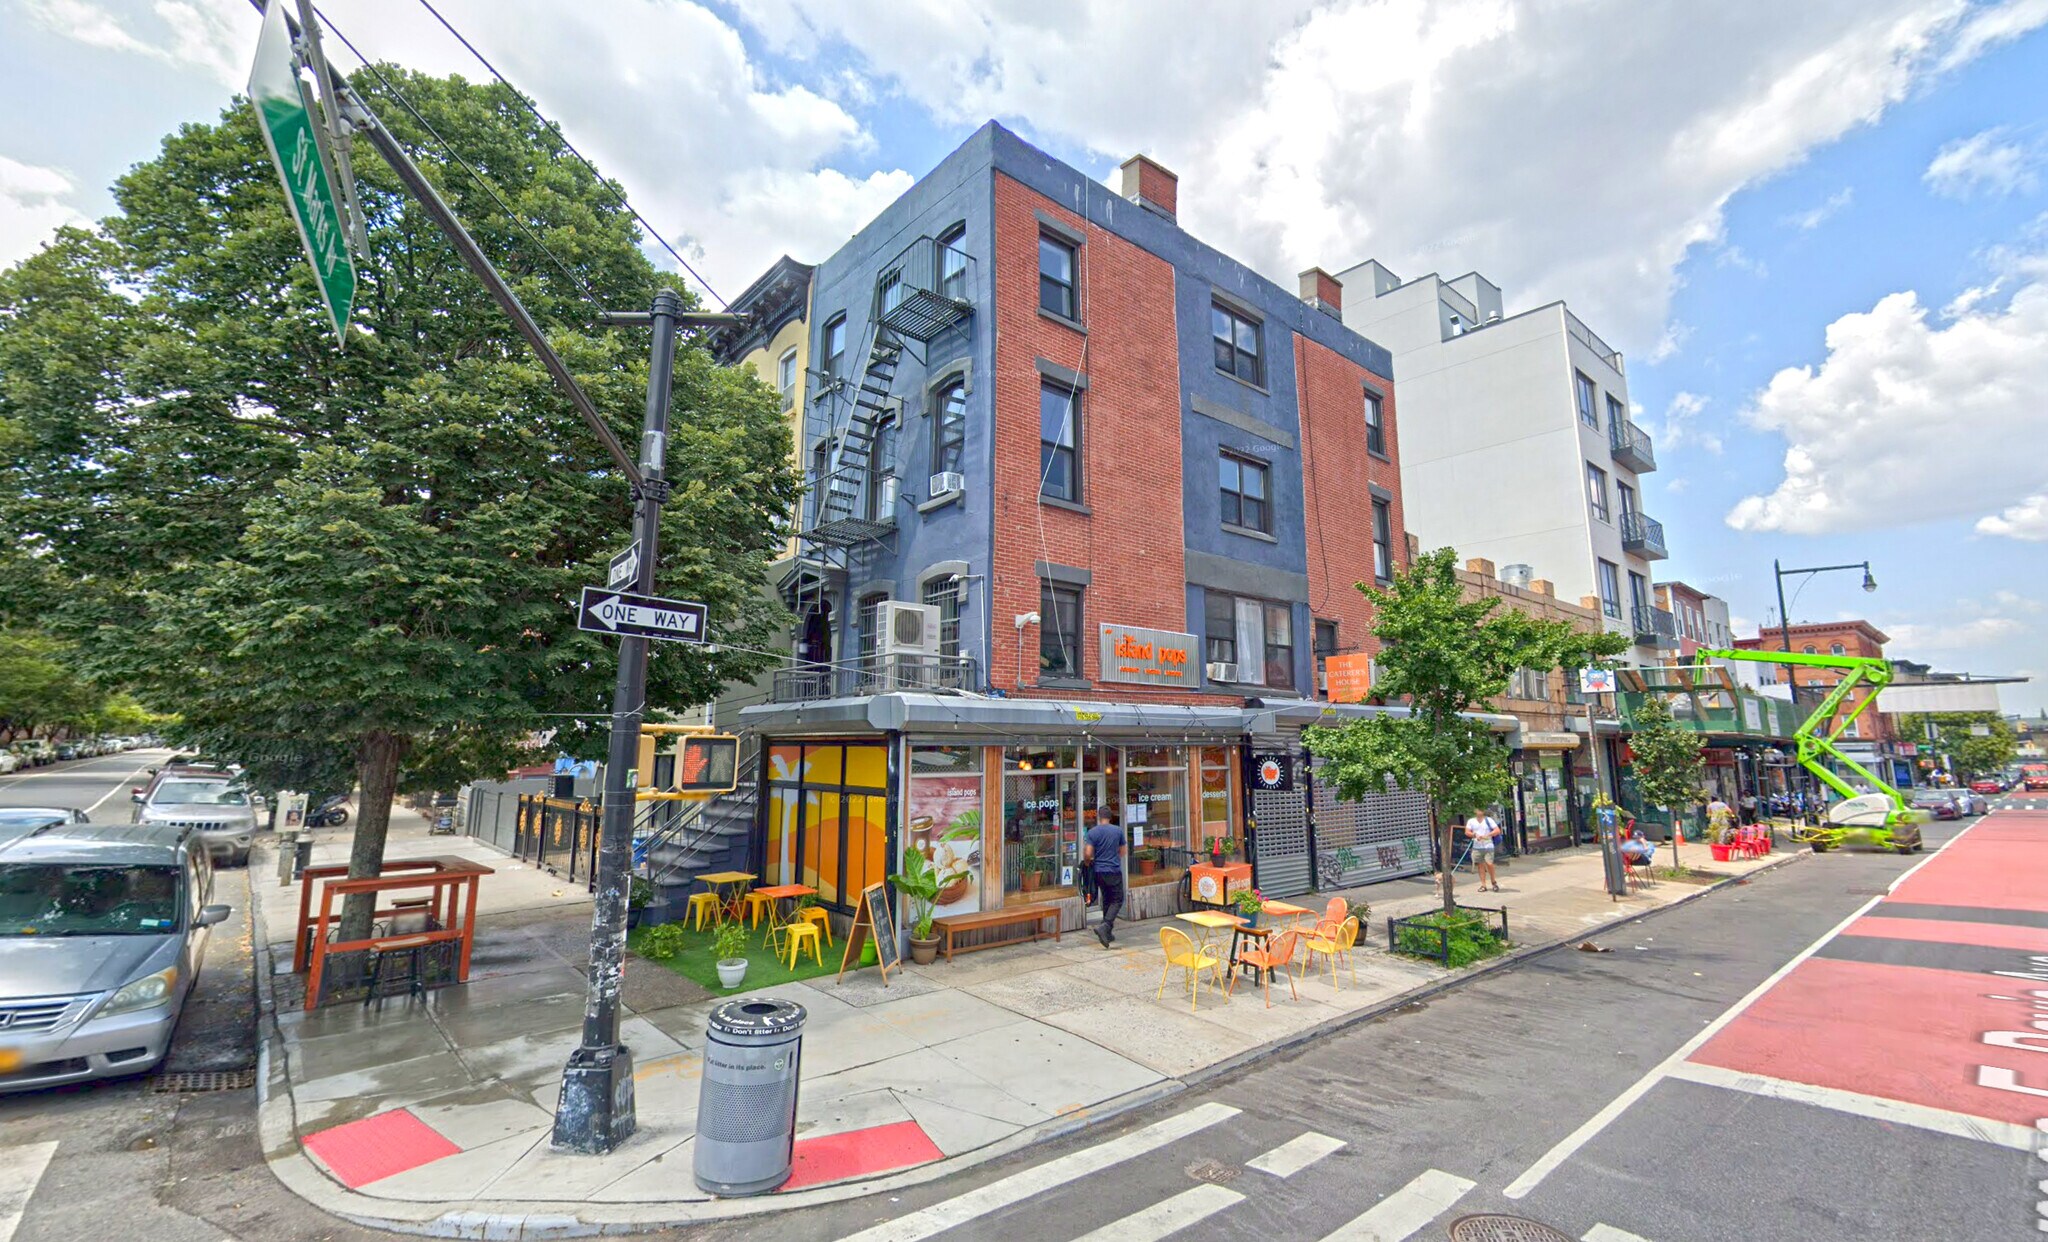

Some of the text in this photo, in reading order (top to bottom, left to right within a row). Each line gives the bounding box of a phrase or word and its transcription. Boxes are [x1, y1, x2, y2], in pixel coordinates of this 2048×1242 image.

[603, 604, 689, 629] ONE WAY
[1114, 635, 1187, 667] island pops
[1328, 669, 1366, 678] CATERER'S
[964, 788, 977, 797] pops
[1138, 793, 1172, 802] ice cream
[1202, 790, 1227, 799] desserts
[1024, 799, 1060, 810] ice pops
[1063, 868, 1071, 880] A
